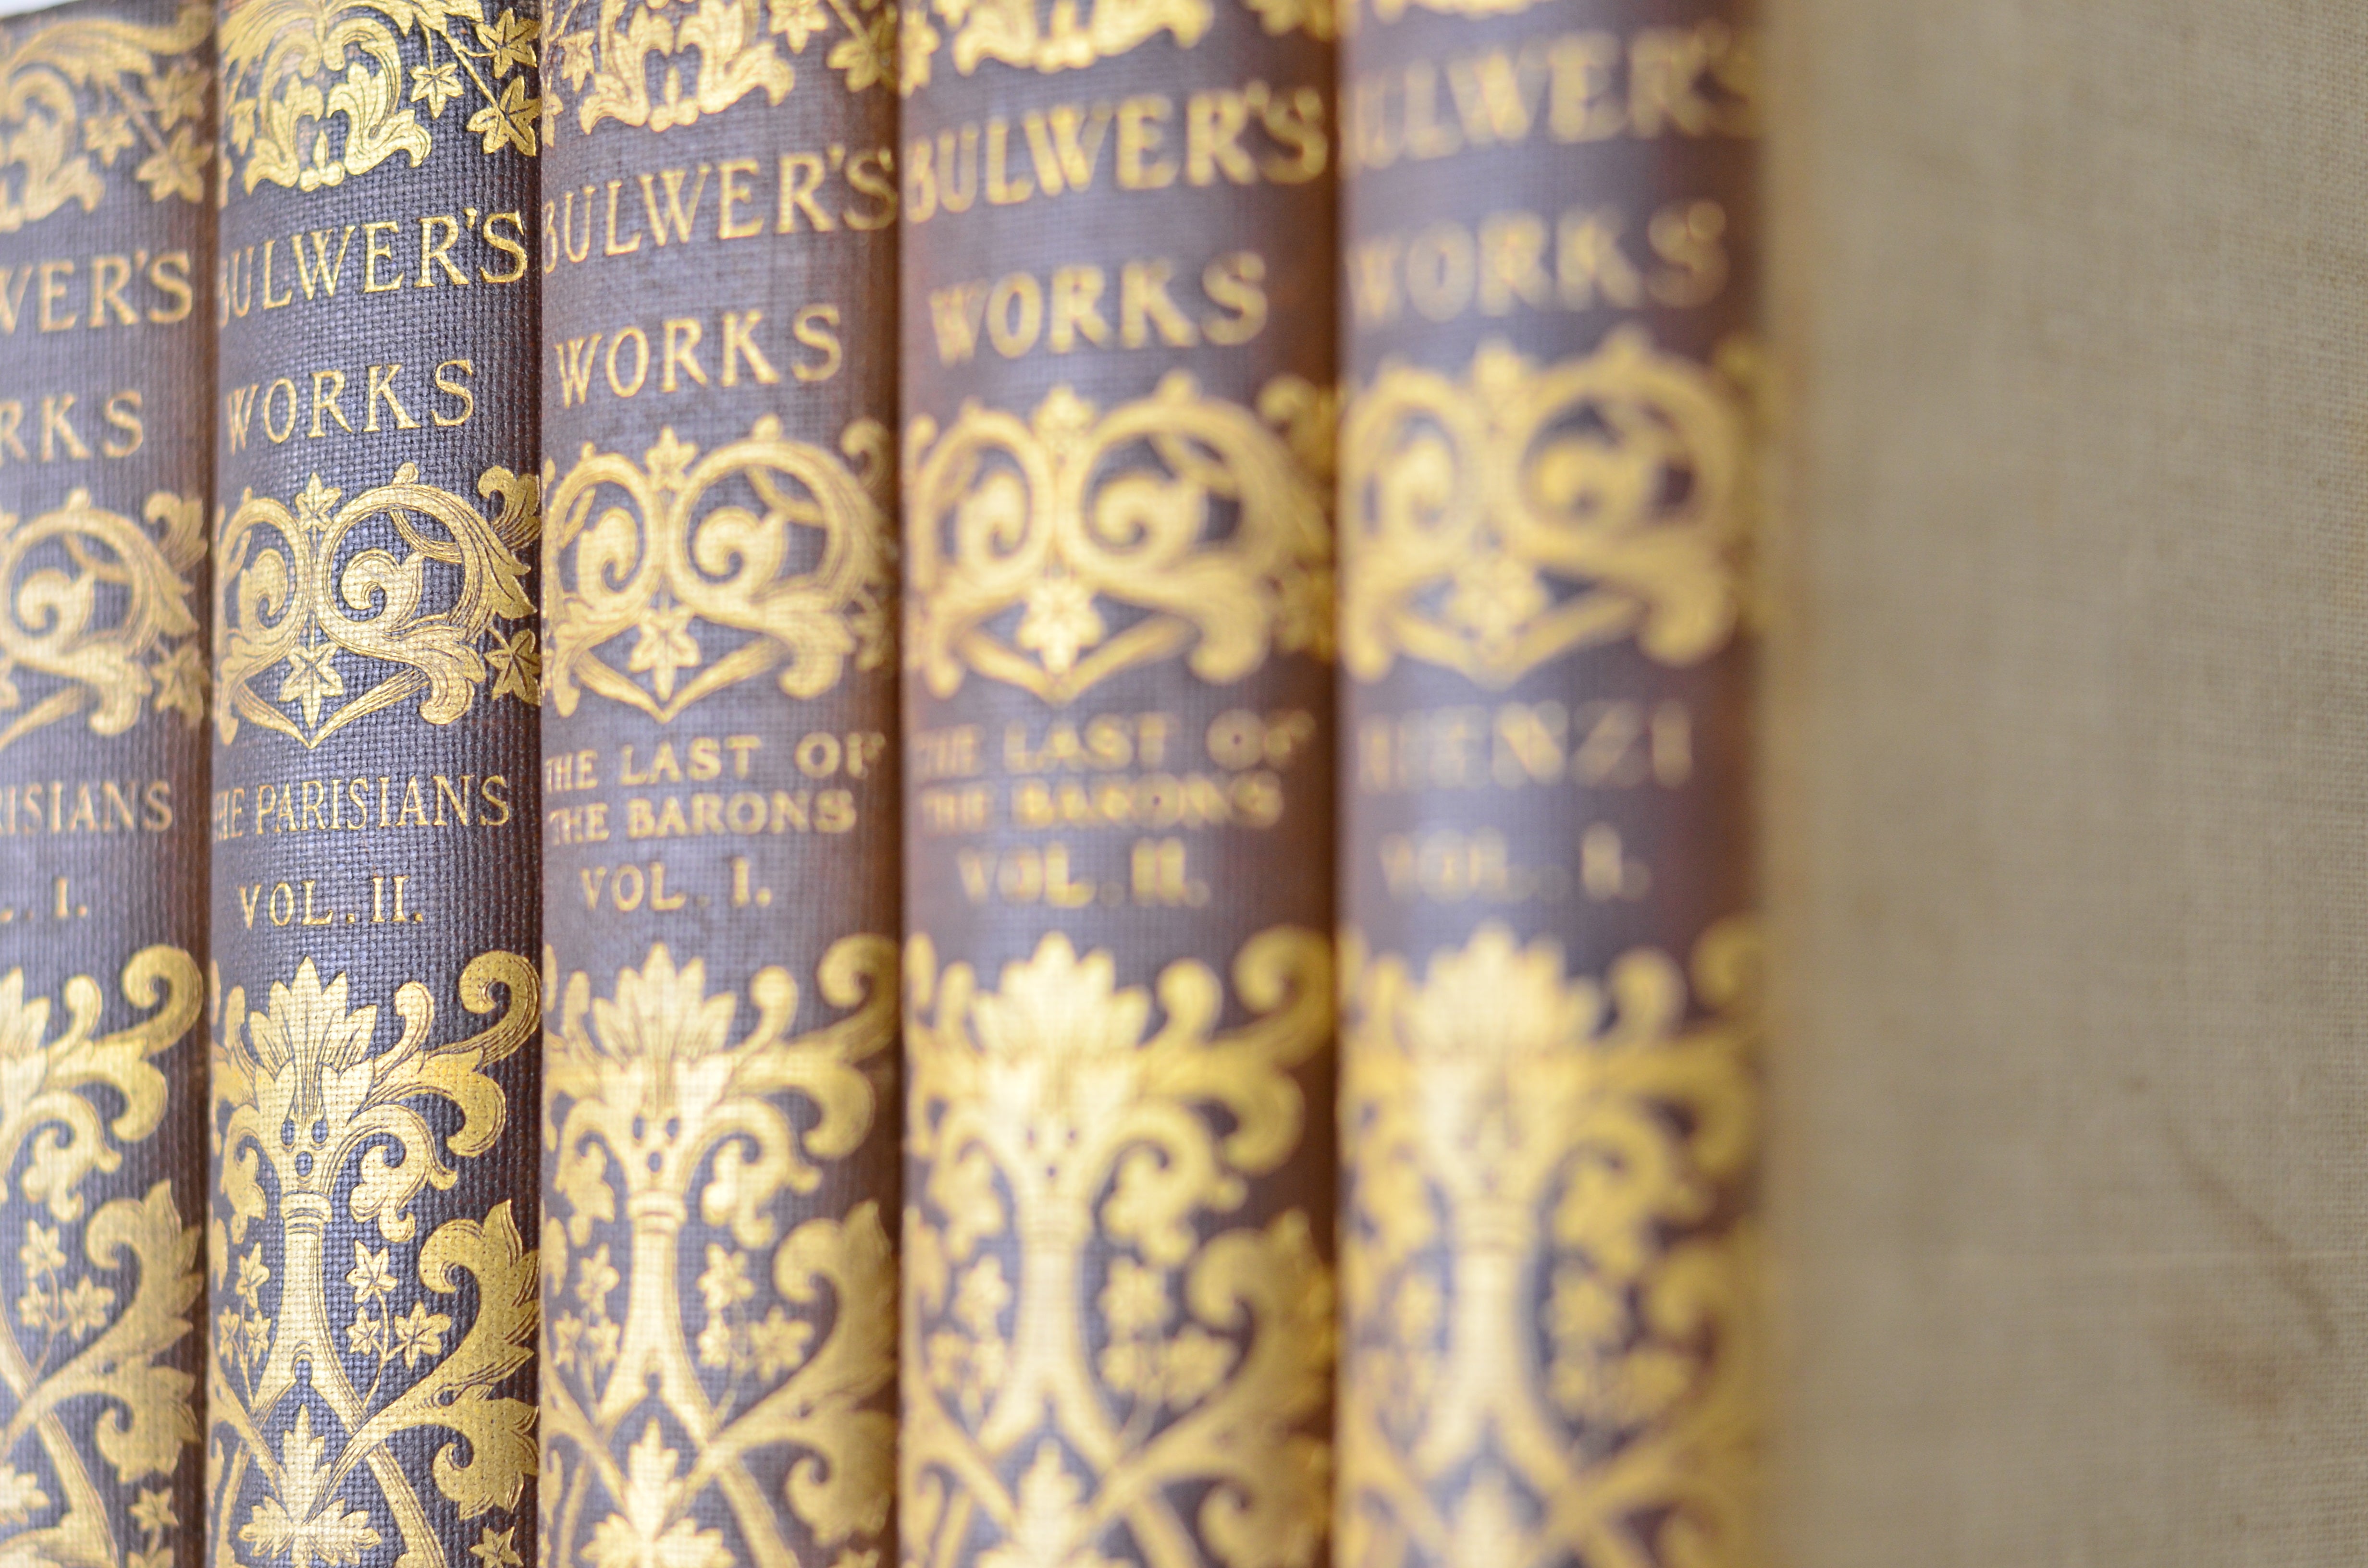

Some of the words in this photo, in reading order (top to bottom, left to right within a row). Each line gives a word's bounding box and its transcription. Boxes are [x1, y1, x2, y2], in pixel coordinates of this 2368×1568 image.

[904, 79, 1328, 224] BULWER'S
[543, 144, 898, 274] BULWER'S
[929, 250, 1268, 368] WORKS
[1350, 199, 1730, 332] WORKS
[555, 304, 842, 408] WORKS
[226, 359, 474, 456] WORKS
[545, 748, 598, 794] THE
[619, 735, 762, 785] LAST
[795, 731, 886, 779] OF
[1004, 712, 1174, 773] LAST
[256, 774, 510, 835] PARISIANS
[549, 802, 610, 846] THE
[627, 789, 857, 839] BARONS
